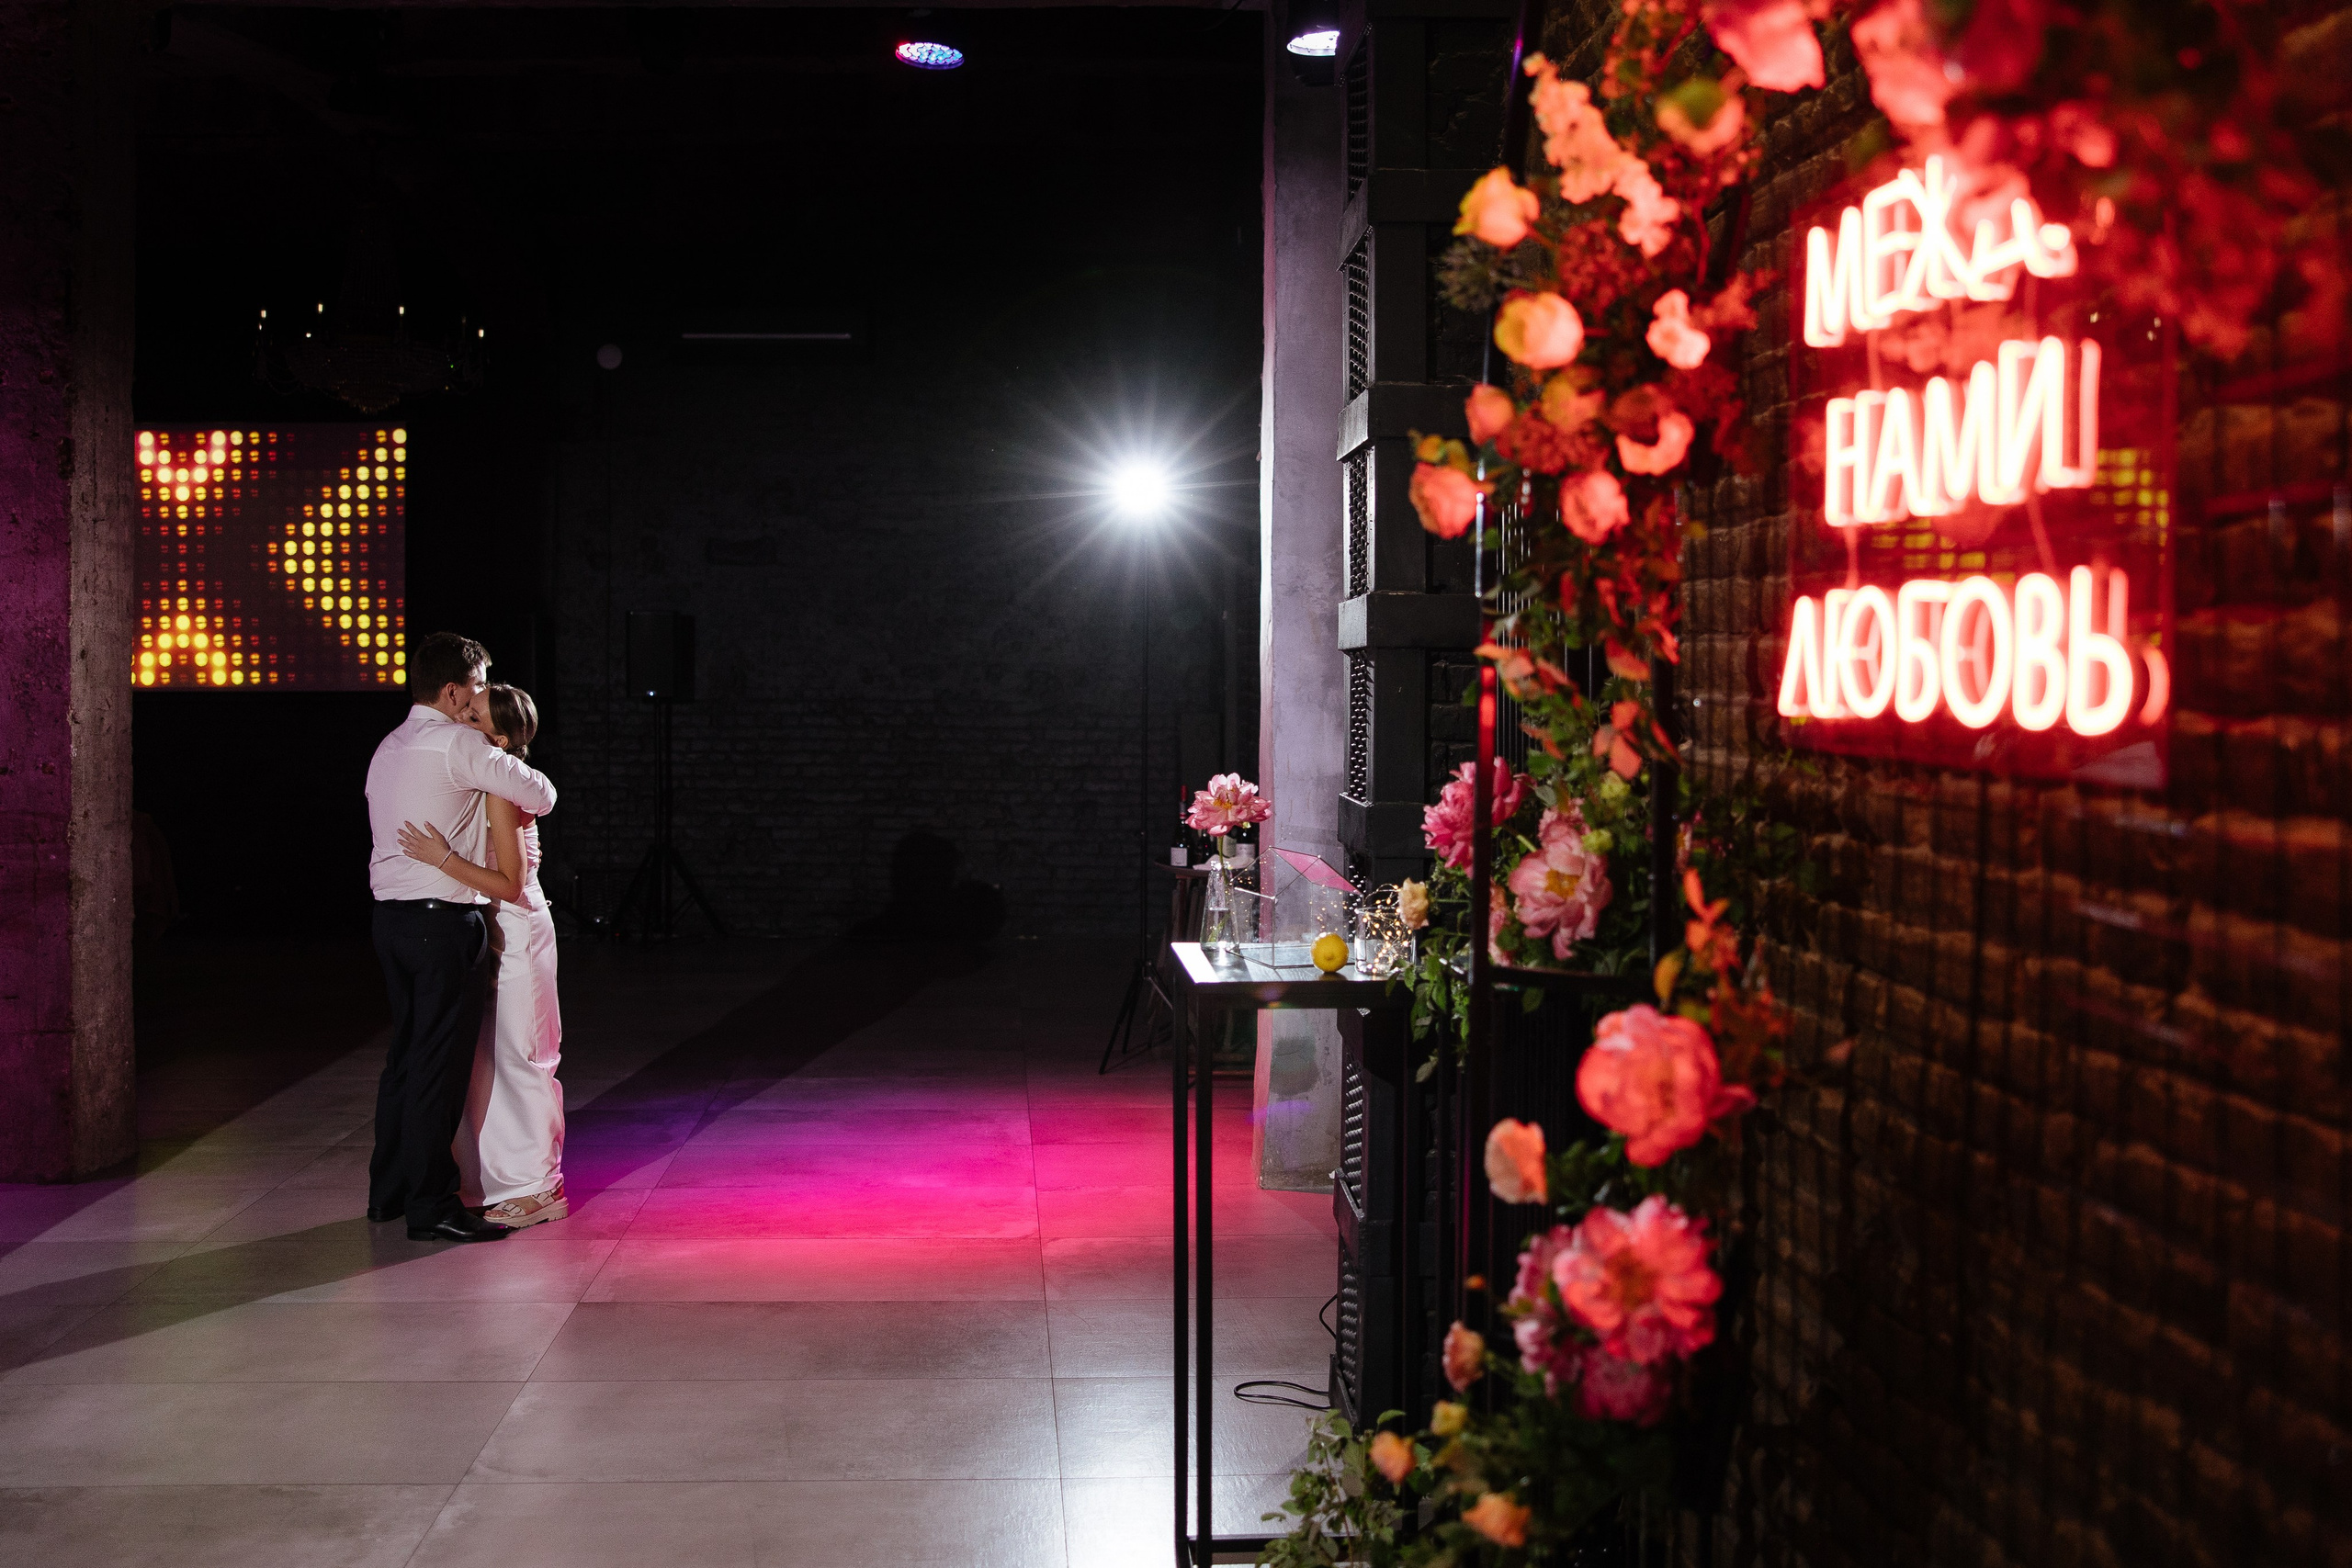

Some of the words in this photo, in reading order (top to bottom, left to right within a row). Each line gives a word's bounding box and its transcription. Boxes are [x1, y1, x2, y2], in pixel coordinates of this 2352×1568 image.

[1804, 153, 2078, 346] МЕЖД
[1826, 335, 2067, 526] НАМИ
[1778, 565, 2135, 738] ЛЮБОВЬ
